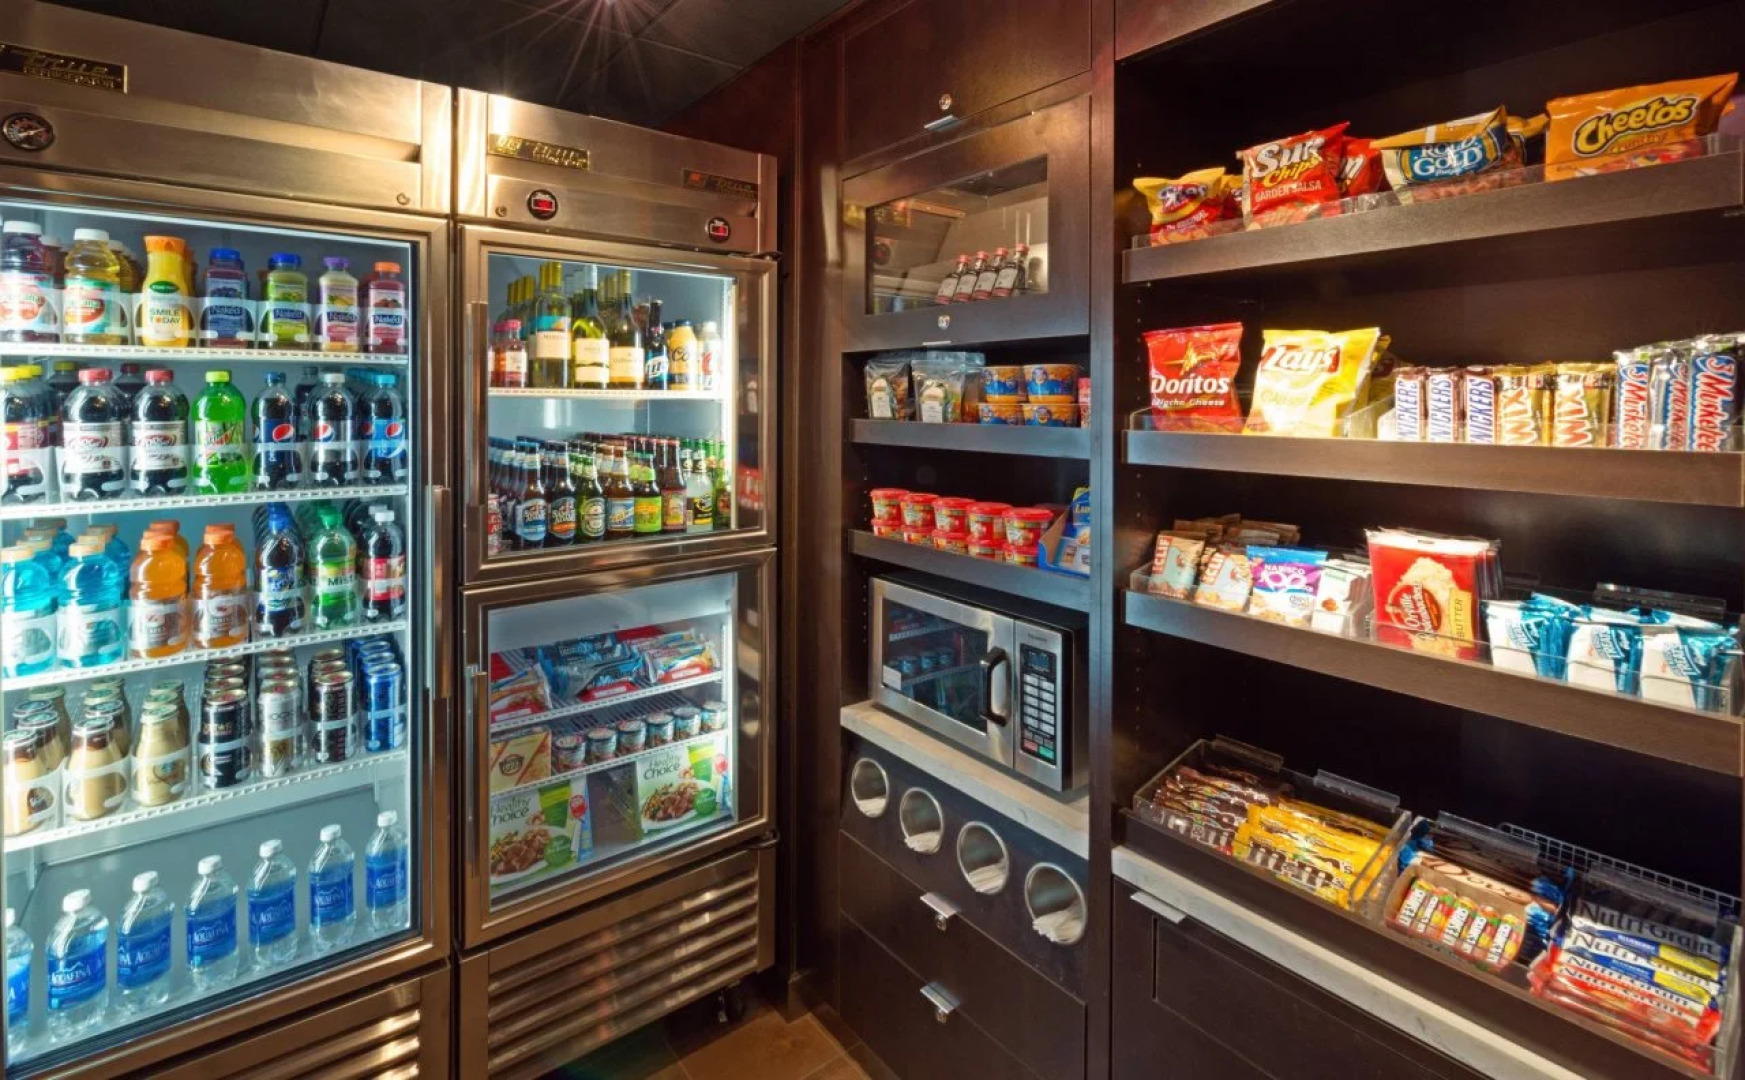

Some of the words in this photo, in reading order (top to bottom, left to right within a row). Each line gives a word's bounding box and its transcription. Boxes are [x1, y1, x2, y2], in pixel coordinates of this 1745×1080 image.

[1576, 97, 1696, 155] Cheetos
[1252, 135, 1325, 178] Sun
[1413, 147, 1483, 176] GOLD
[1263, 154, 1323, 188] Chips
[1256, 184, 1291, 202] GARDEN
[150, 309, 180, 317] SMILE
[212, 306, 240, 315] Naked
[274, 308, 302, 318] Naked
[329, 312, 357, 320] Naked
[377, 315, 401, 325] Naked
[1707, 356, 1735, 375] 3
[1151, 374, 1231, 394] Doritos
[1189, 397, 1225, 406] Cheese
[1397, 380, 1418, 441] NICKERS
[1431, 379, 1451, 441] NICKERS
[1469, 379, 1493, 442] NICKERS
[1503, 388, 1534, 445] WIX
[1557, 389, 1590, 445] WIX
[1697, 371, 1734, 452] Musketee
[1264, 565, 1306, 574] NABISCO
[1455, 598, 1465, 638] BUTTER
[644, 763, 680, 780] Choice
[493, 808, 530, 825] hoice
[51, 966, 92, 984] AQUAFINA
